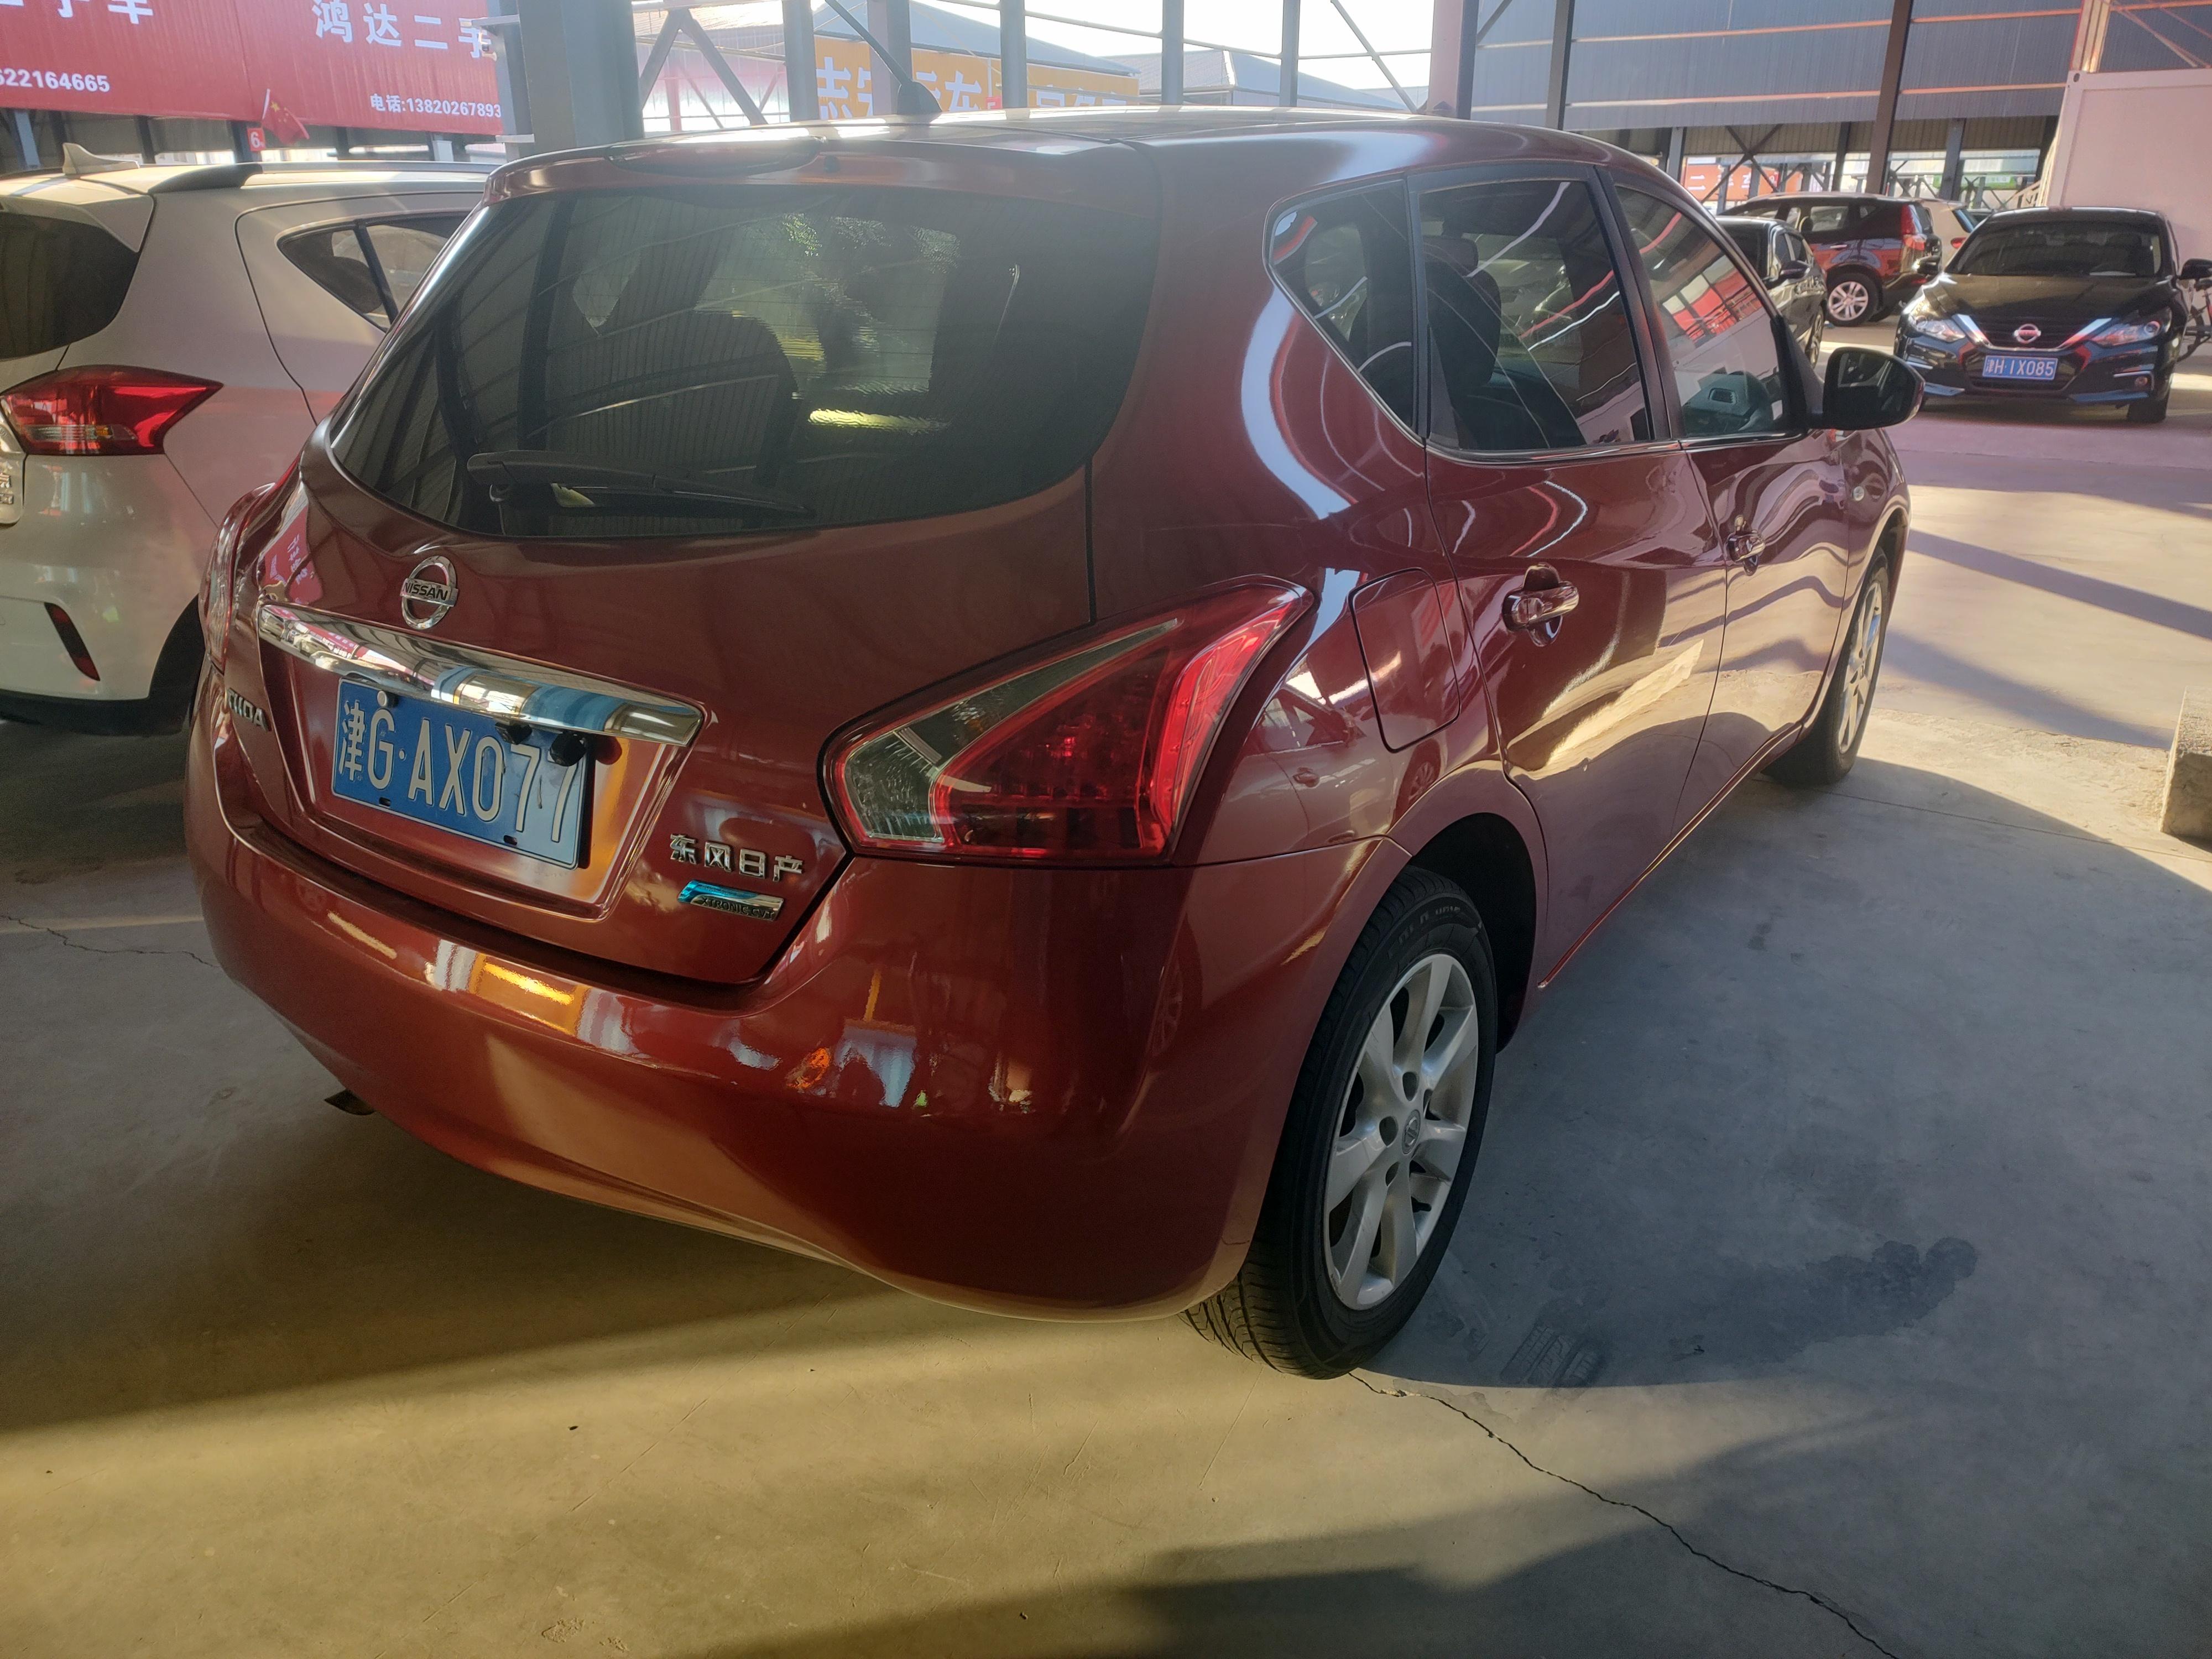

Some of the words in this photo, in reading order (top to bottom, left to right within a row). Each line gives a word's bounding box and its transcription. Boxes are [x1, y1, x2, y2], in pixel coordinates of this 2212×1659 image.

[403, 582, 448, 601] NISSAN
[338, 700, 577, 843] 津G·AX077
[670, 833, 803, 883] 东风日产
[701, 896, 750, 915] XTRONIC
